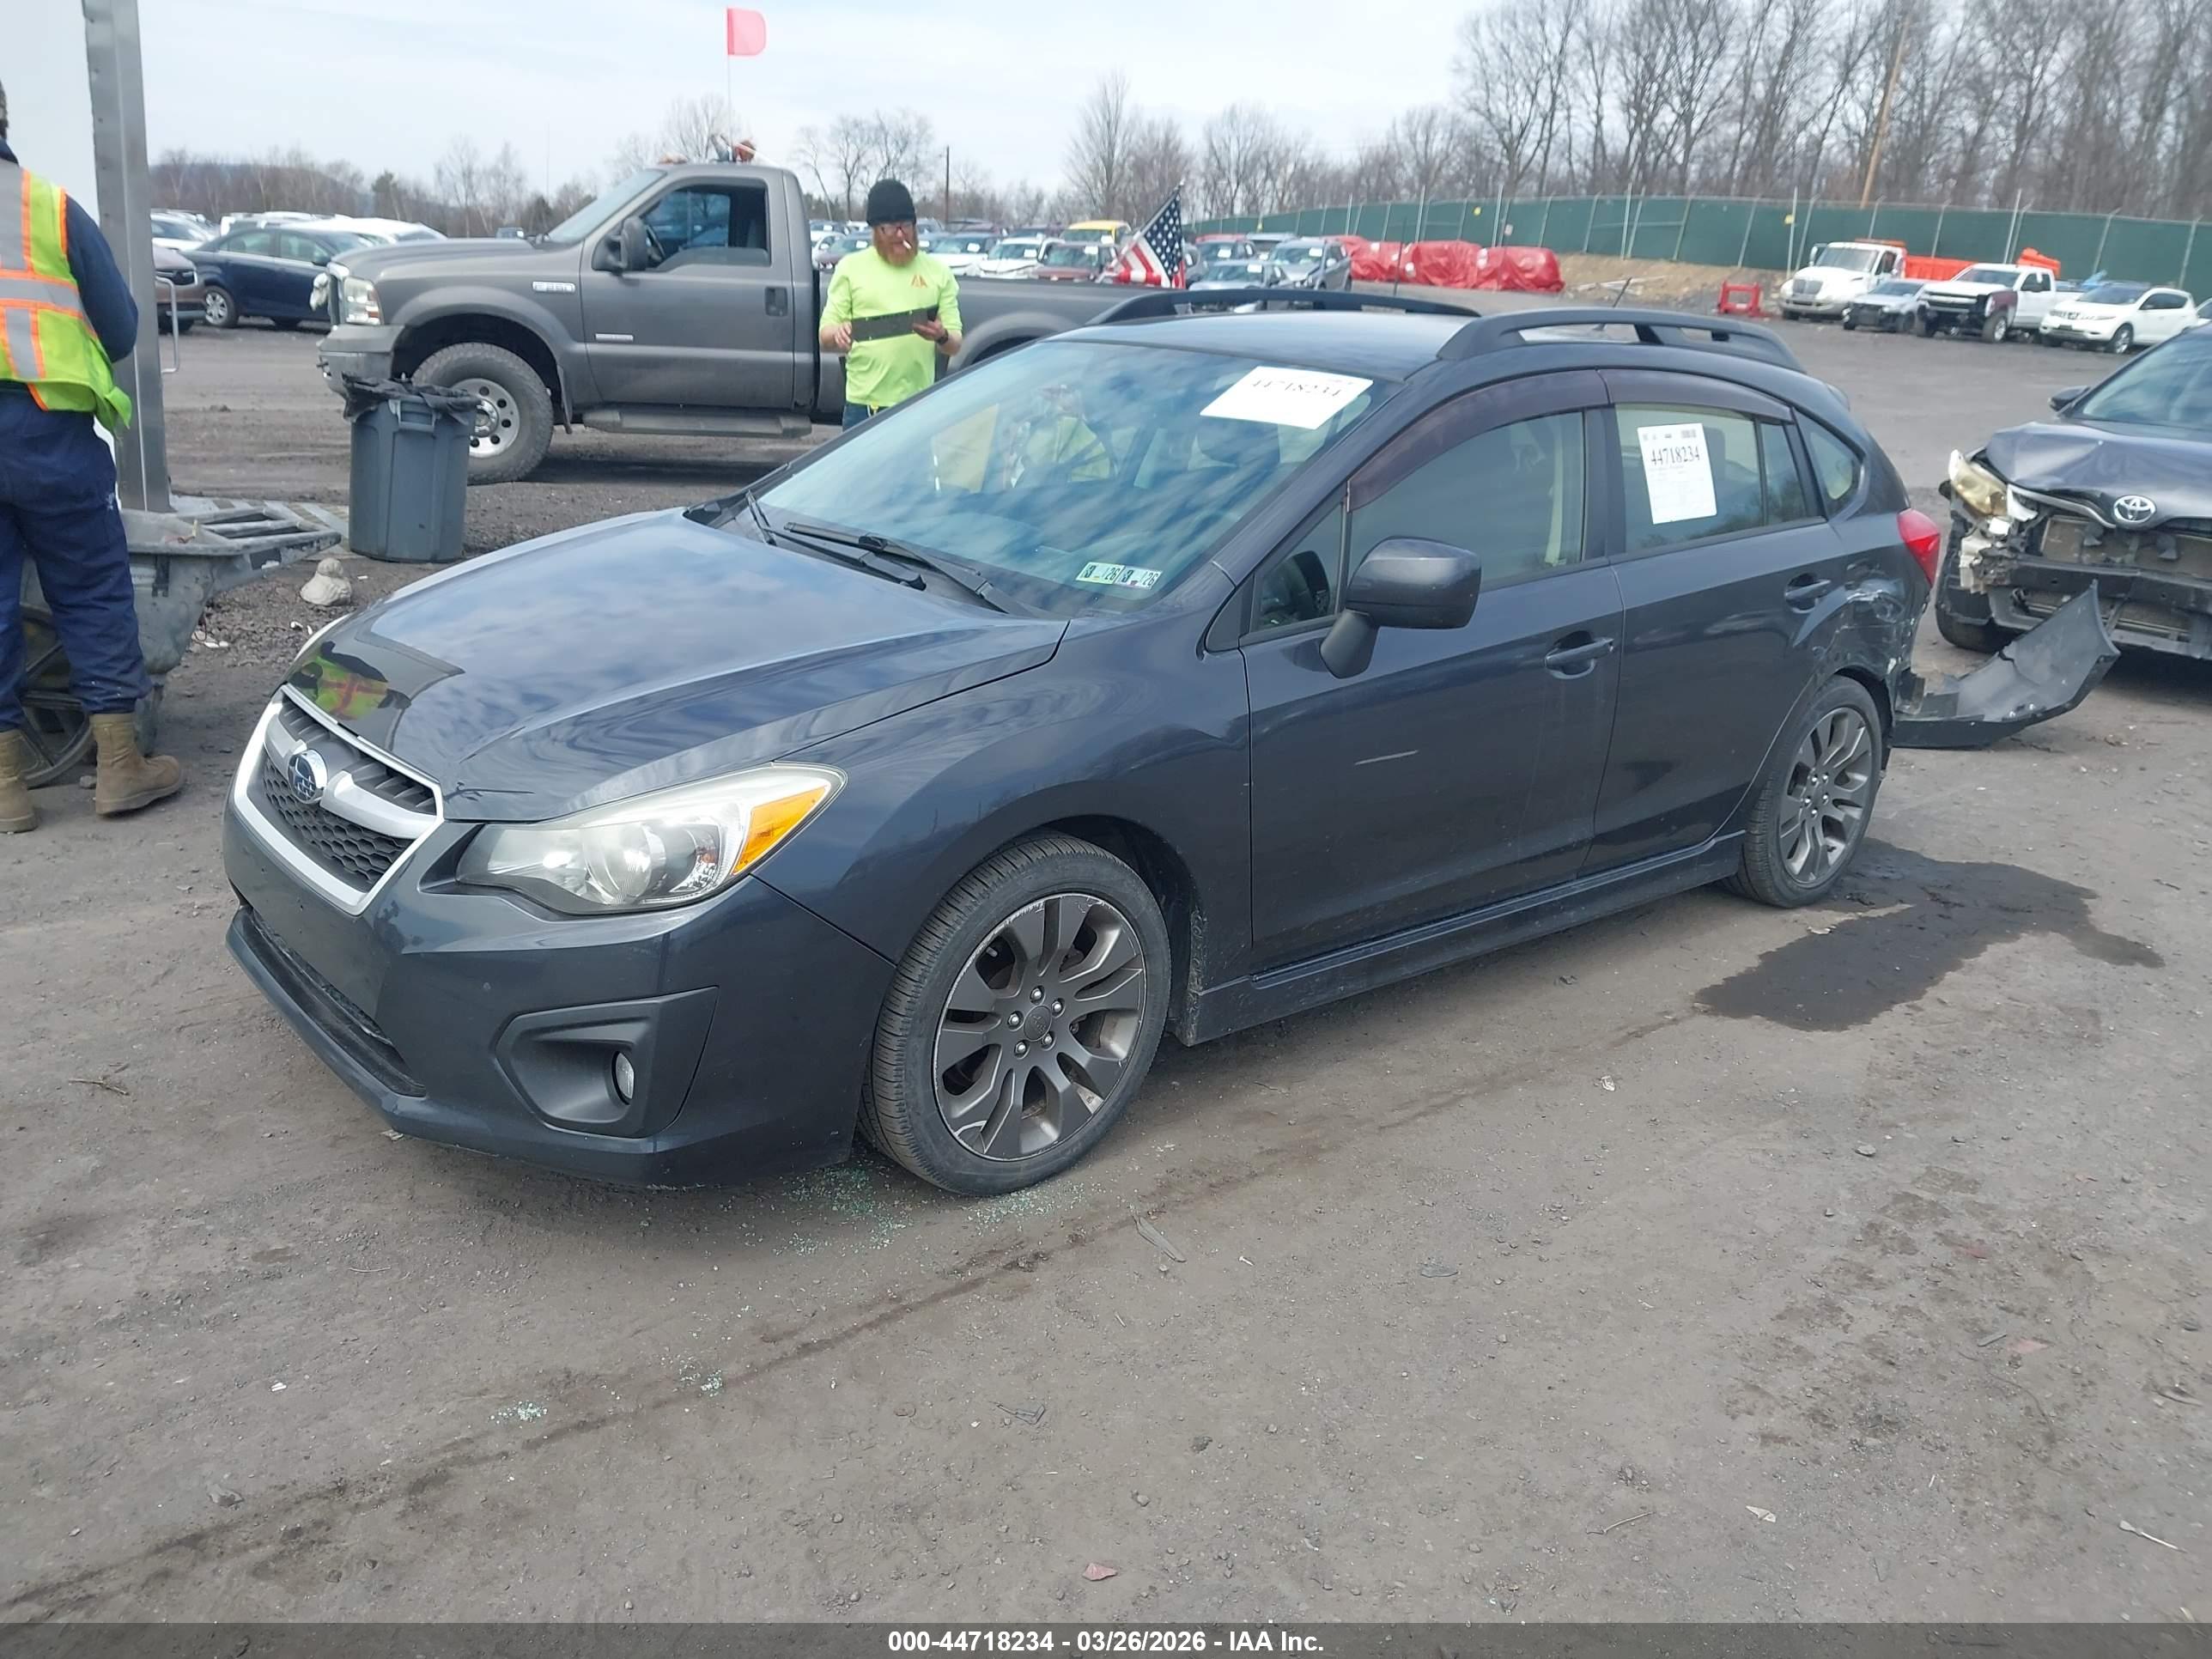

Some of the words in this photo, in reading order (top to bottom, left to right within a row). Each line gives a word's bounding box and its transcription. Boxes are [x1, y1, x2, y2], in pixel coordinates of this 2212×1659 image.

[1651, 446, 1700, 465] 44718234
[1085, 565, 1097, 578] 3
[1121, 569, 1134, 582] 3
